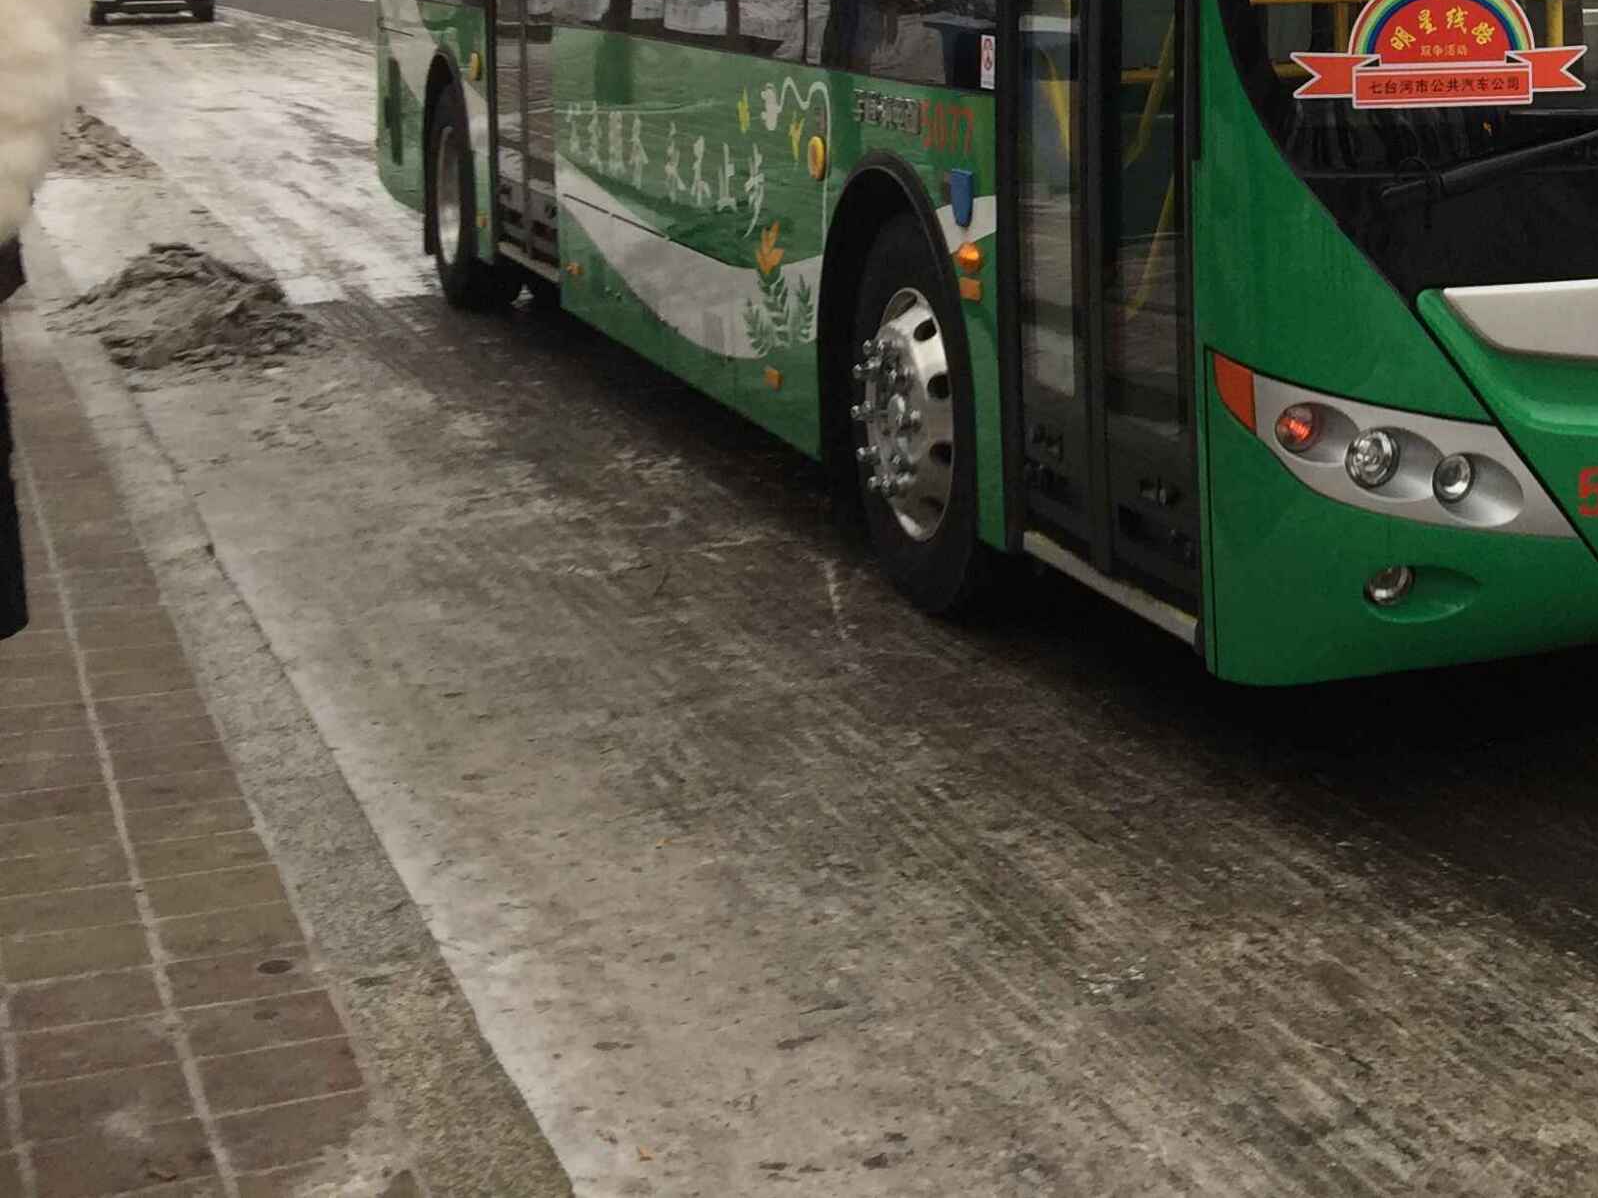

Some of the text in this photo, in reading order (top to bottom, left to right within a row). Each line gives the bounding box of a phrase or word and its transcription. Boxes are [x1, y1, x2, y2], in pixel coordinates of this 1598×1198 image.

[1368, 74, 1520, 95] 七台河市公共汽车公司
[920, 99, 976, 156] 5077
